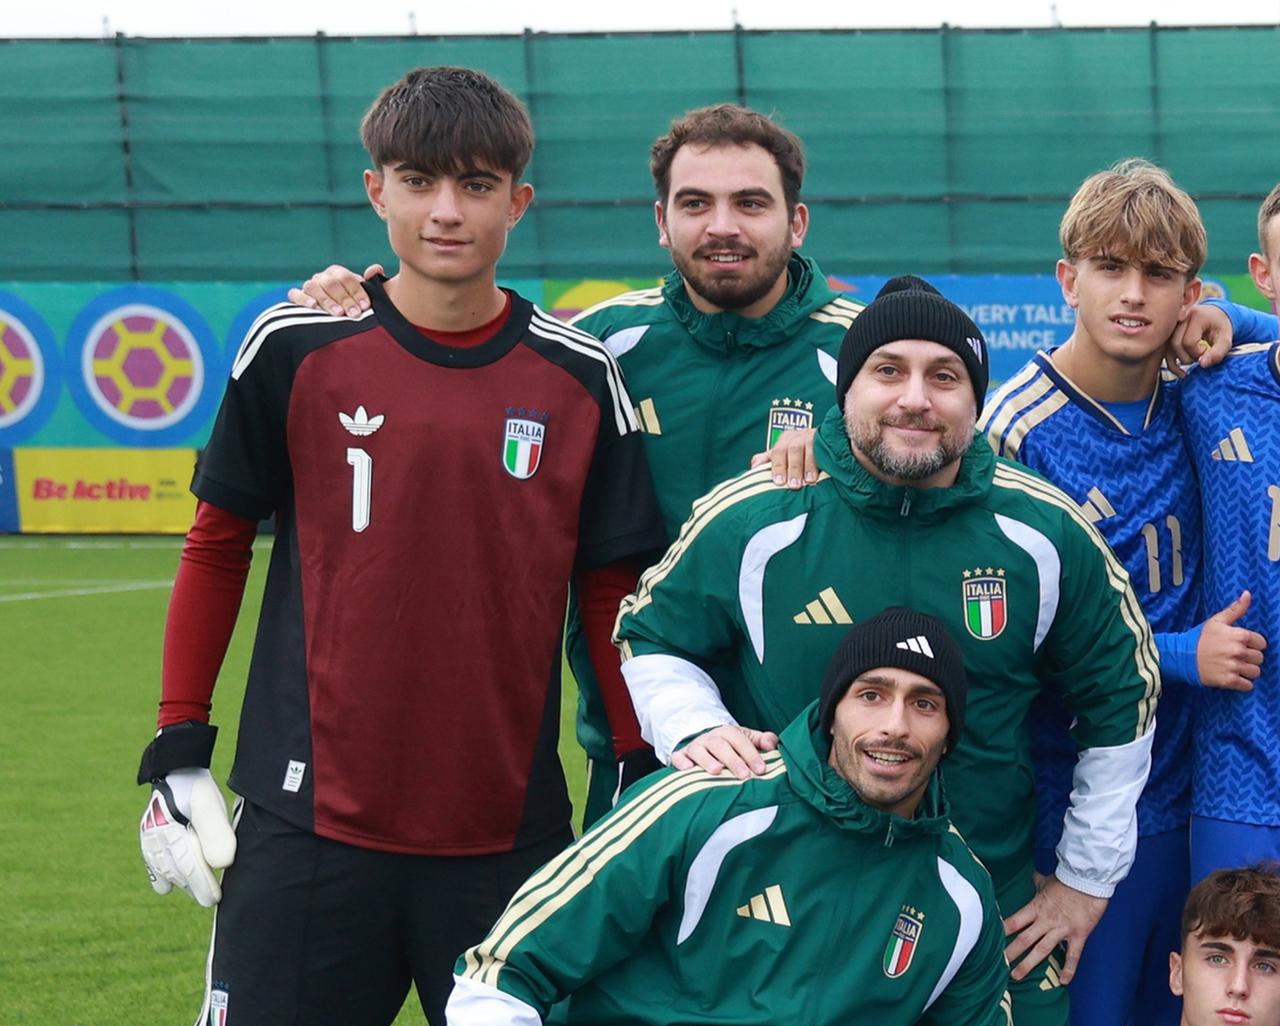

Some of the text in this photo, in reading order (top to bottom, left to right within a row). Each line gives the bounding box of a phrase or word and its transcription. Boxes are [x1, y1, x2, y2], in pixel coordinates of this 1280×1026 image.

[963, 304, 1075, 323] VERY TALE
[985, 330, 1055, 349] HANCE
[773, 412, 807, 427] ITALIA
[508, 422, 542, 438] ITALIA
[33, 478, 151, 501] Be Active
[347, 447, 372, 532] 1
[1141, 514, 1183, 593] 11
[967, 583, 1002, 596] ITALIA
